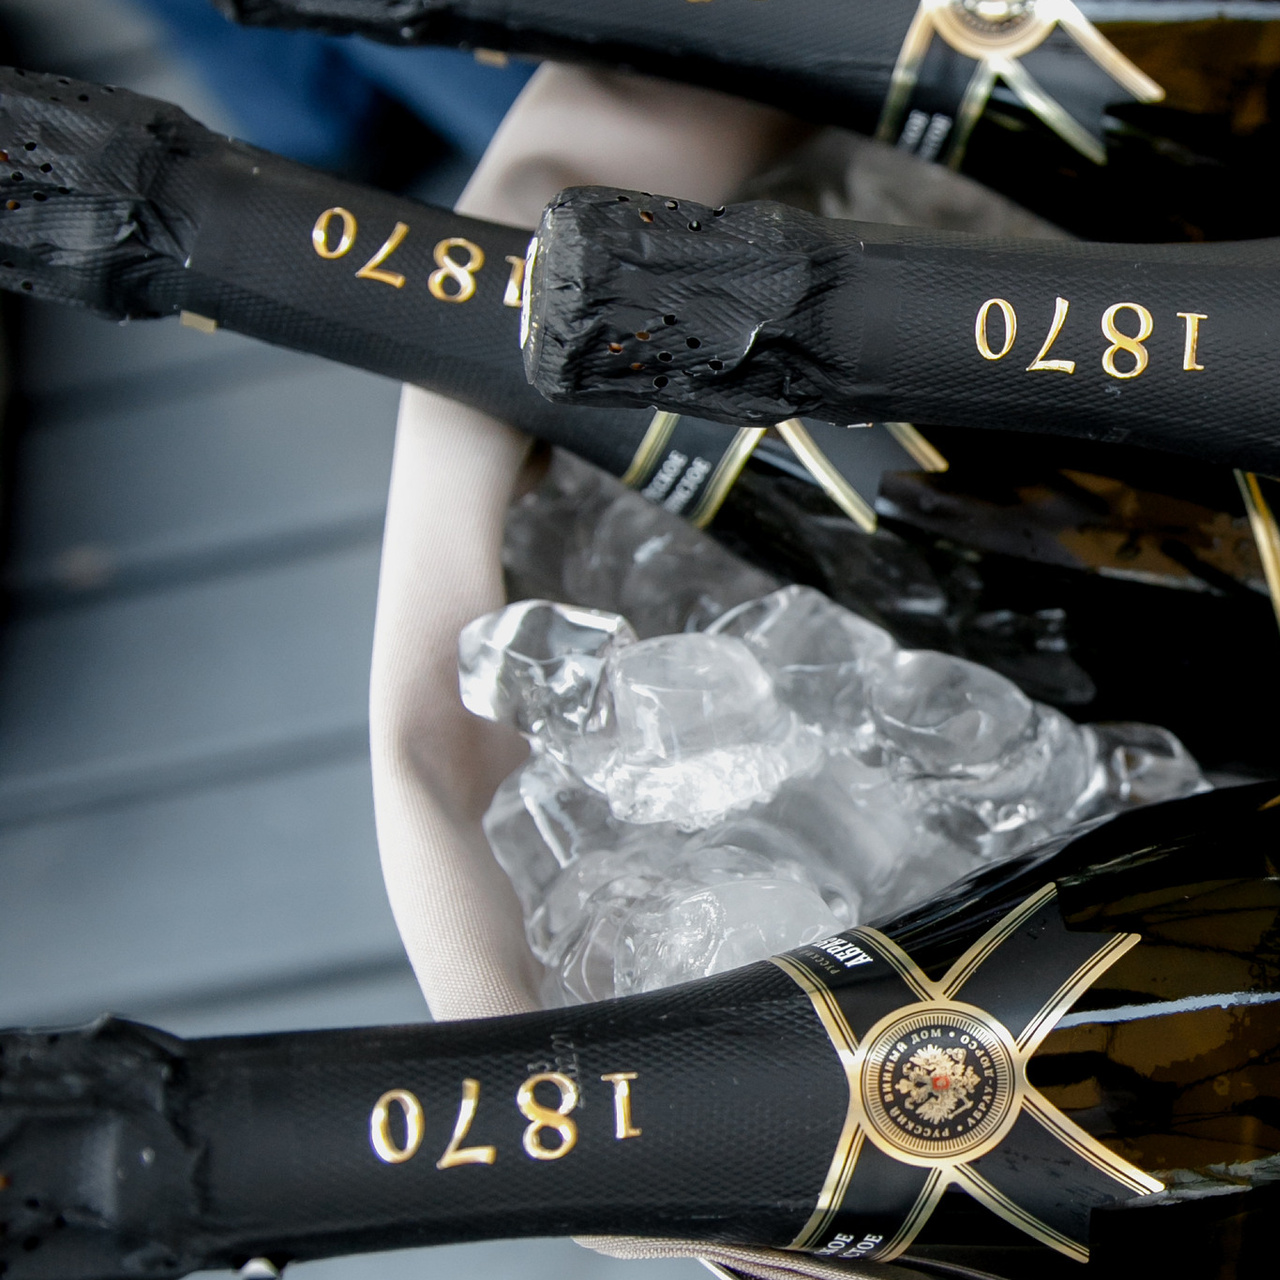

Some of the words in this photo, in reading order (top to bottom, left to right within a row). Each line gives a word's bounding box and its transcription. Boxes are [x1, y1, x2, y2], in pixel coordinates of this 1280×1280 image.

[312, 206, 527, 308] 1870
[973, 296, 1208, 380] 1870
[880, 1040, 908, 1102] ВИННЫЙ
[910, 1027, 944, 1044] ДОМ
[369, 1071, 643, 1170] 1870
[886, 1098, 952, 1139] РУССКИЙ
